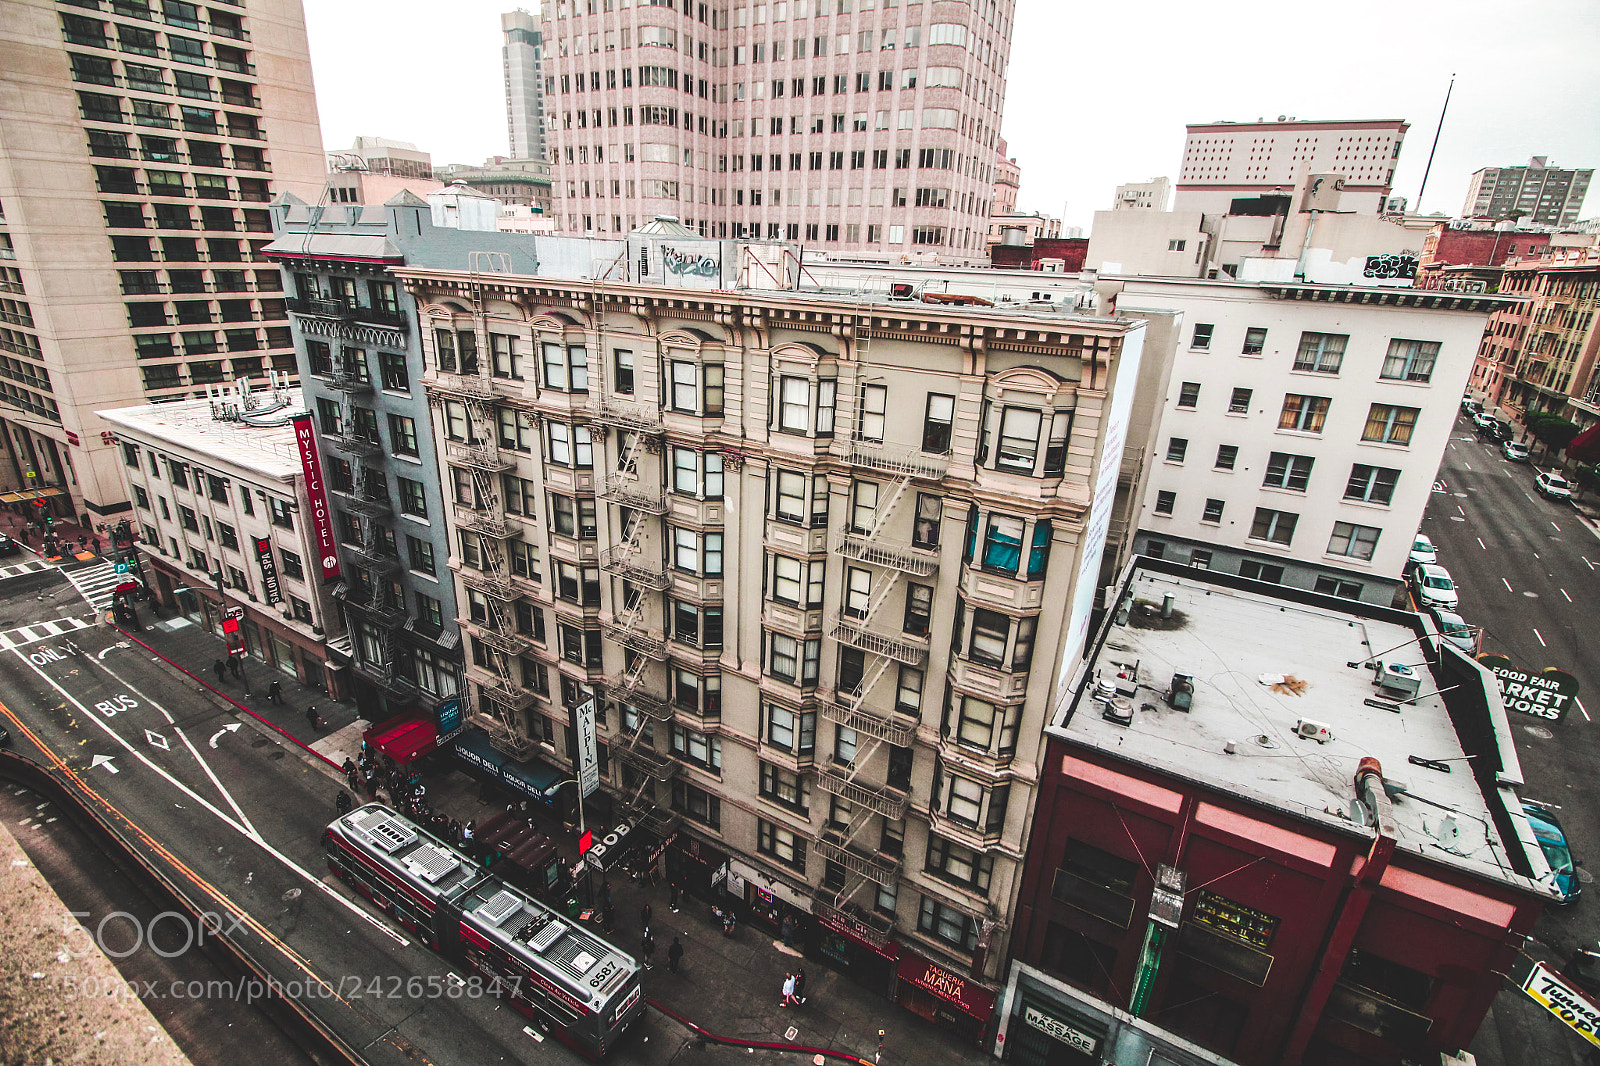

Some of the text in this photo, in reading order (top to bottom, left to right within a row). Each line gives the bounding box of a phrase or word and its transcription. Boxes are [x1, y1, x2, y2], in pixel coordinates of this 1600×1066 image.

[299, 428, 330, 547] MYSTIC HOTEL
[261, 552, 273, 570] SPA
[266, 576, 280, 604] SALON
[30, 643, 77, 666] ONLY
[1492, 666, 1561, 691] FOOD FAIR
[94, 694, 139, 718] BUS
[1497, 678, 1569, 708] ARKET
[1501, 695, 1561, 720] UORS
[454, 744, 481, 764] LIQUOR
[482, 759, 499, 773] DELI
[503, 770, 526, 788] LIQUOR
[527, 784, 542, 797] DELI
[589, 960, 618, 988] 6587
[929, 964, 965, 988] TAQUERIA
[1548, 997, 1593, 1033] TOP
[1027, 1012, 1091, 1050] MASSAGE
